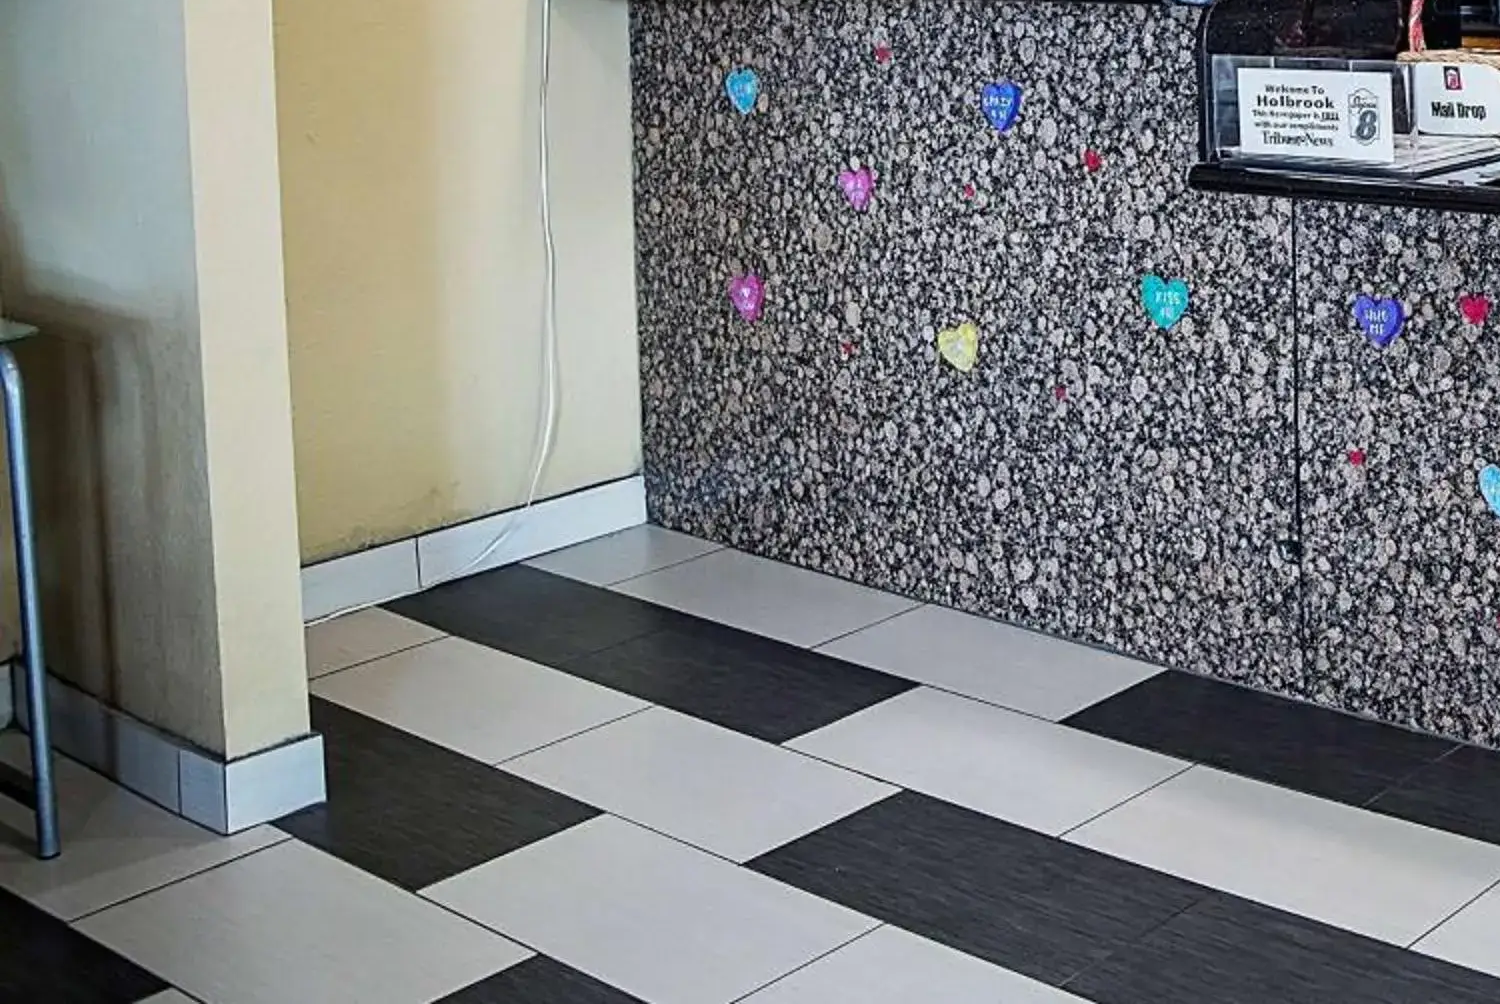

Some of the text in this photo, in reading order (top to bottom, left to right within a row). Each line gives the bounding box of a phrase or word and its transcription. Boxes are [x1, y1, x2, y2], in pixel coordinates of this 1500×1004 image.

[1265, 84, 1325, 95] Welcome To
[1256, 95, 1335, 109] Holbrook
[1431, 101, 1487, 121] Mail Drop
[1355, 109, 1377, 141] 8
